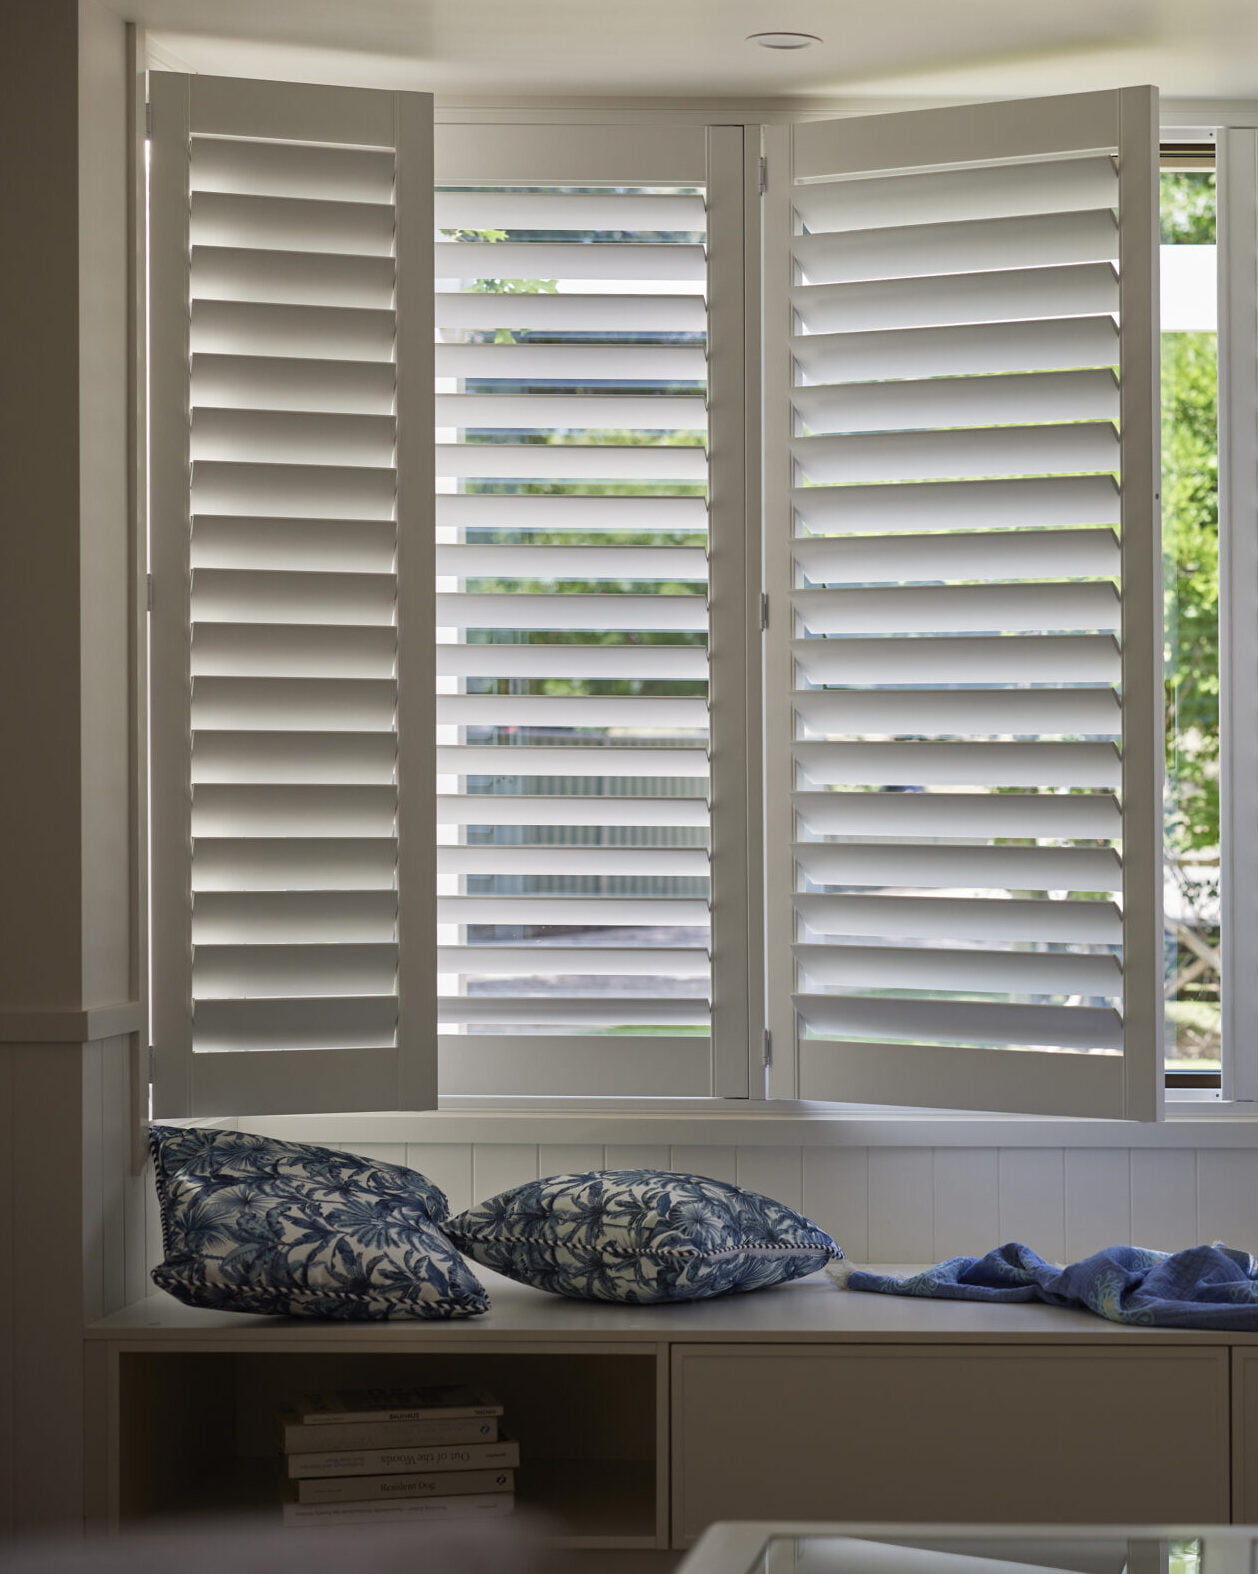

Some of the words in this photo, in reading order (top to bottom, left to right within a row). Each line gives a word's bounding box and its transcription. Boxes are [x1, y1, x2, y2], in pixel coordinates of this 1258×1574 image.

[381, 1454, 416, 1466] Woods
[417, 1453, 434, 1464] the
[436, 1453, 448, 1464] of
[449, 1452, 471, 1462] Out
[380, 1481, 416, 1492] Resident
[418, 1480, 436, 1491] Dog
